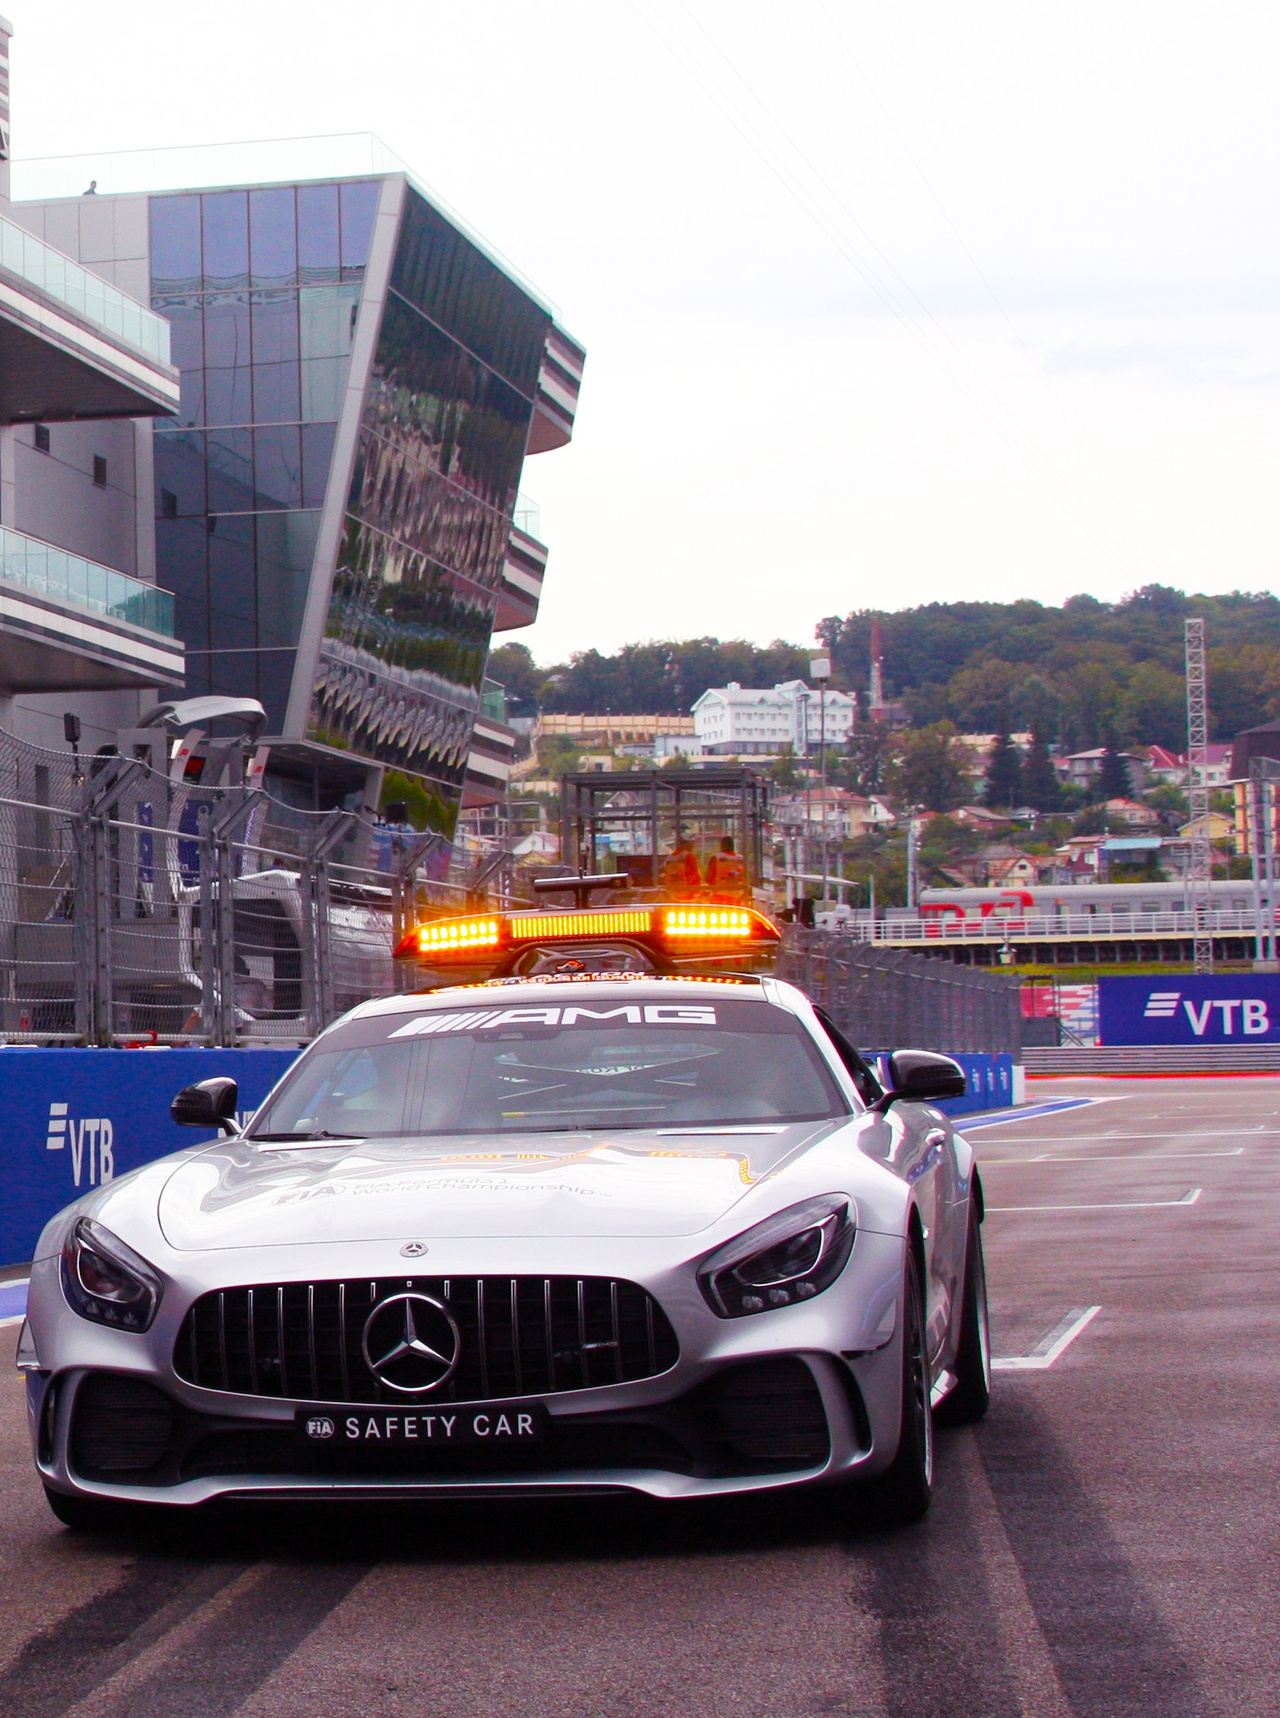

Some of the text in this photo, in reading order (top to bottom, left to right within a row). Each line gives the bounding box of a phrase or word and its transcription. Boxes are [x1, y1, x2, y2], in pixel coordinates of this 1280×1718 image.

[481, 1006, 717, 1029] AMG
[1183, 999, 1270, 1035] VTB
[69, 1119, 114, 1187] VTB
[352, 1184, 421, 1195] World
[425, 1183, 596, 1196] Championship
[398, 1178, 494, 1187] Formula
[346, 1415, 456, 1438] SAFETY
[473, 1413, 534, 1436] CAR
